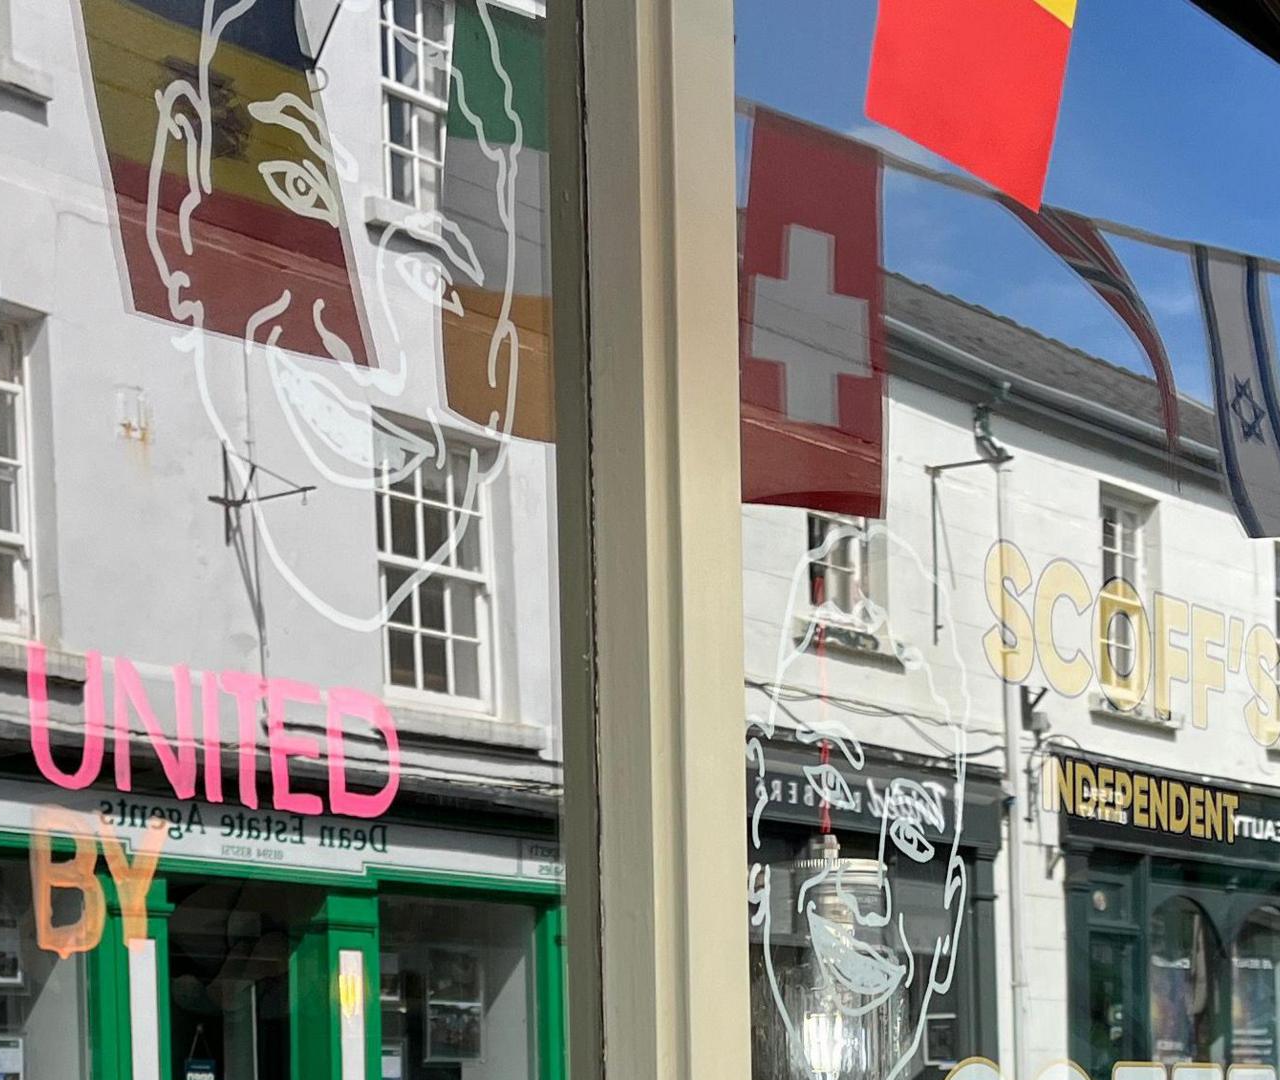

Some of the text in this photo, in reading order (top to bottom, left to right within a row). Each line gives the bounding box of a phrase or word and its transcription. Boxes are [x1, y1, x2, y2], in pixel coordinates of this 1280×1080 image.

[28, 645, 401, 819] UNITED
[1041, 754, 1240, 845] INDEPENDENT
[31, 805, 167, 960] BY
